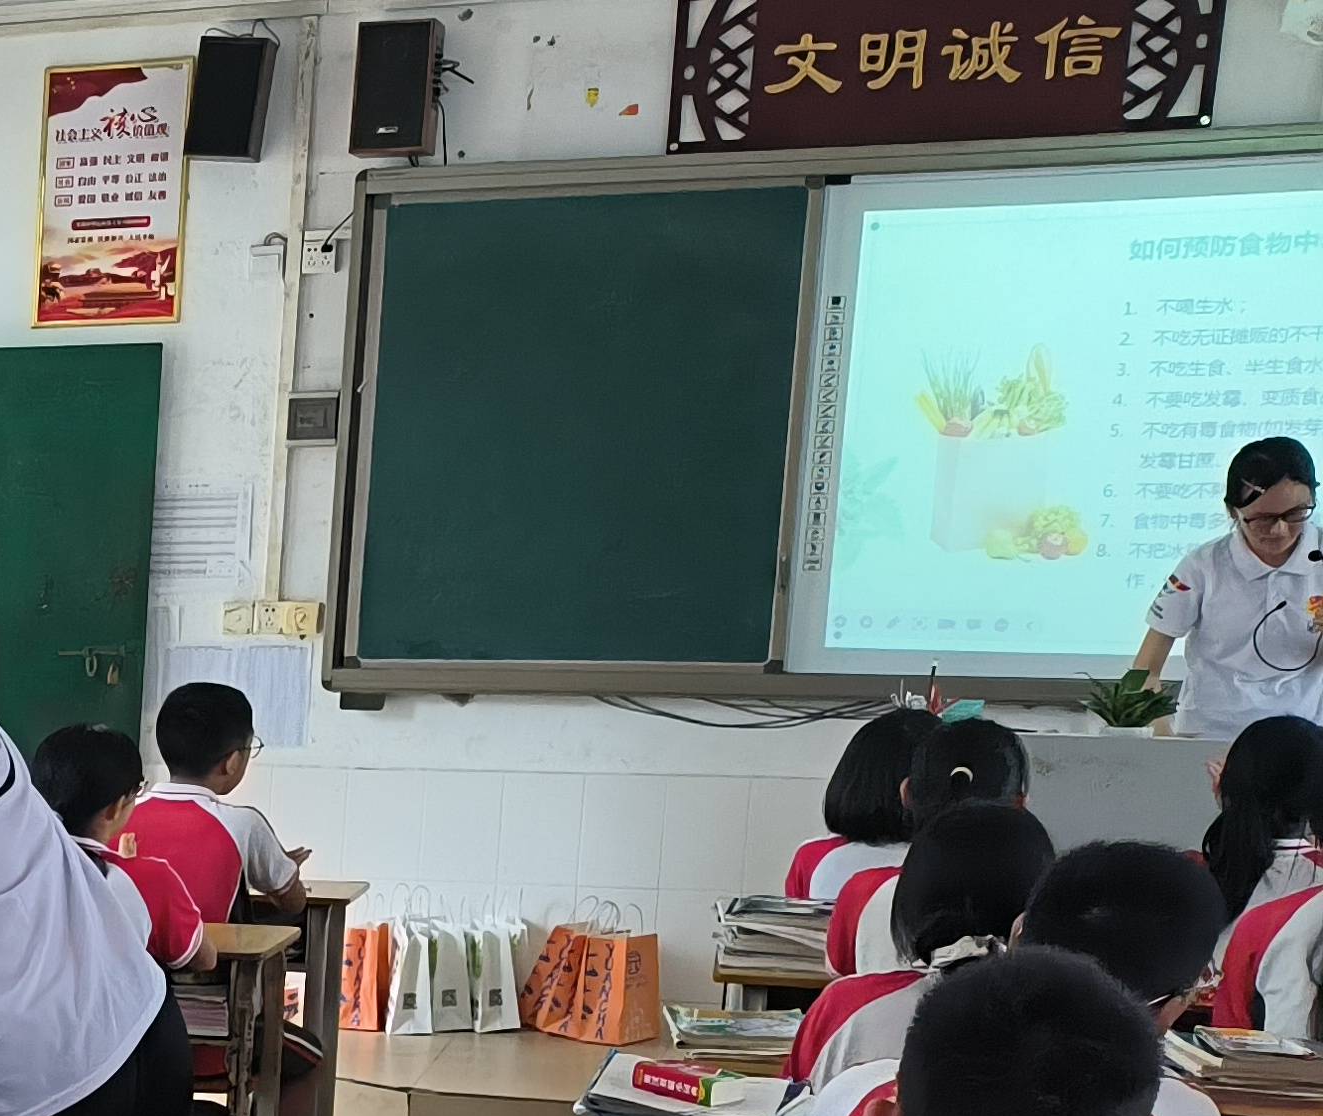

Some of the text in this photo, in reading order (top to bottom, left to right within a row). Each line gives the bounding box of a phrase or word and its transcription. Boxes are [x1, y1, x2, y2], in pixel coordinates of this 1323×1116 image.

[763, 14, 1122, 94] 文明诚信
[1128, 229, 1323, 262] 如何预防食物中
[1145, 385, 1323, 408] 不要吃发霉、变质食
